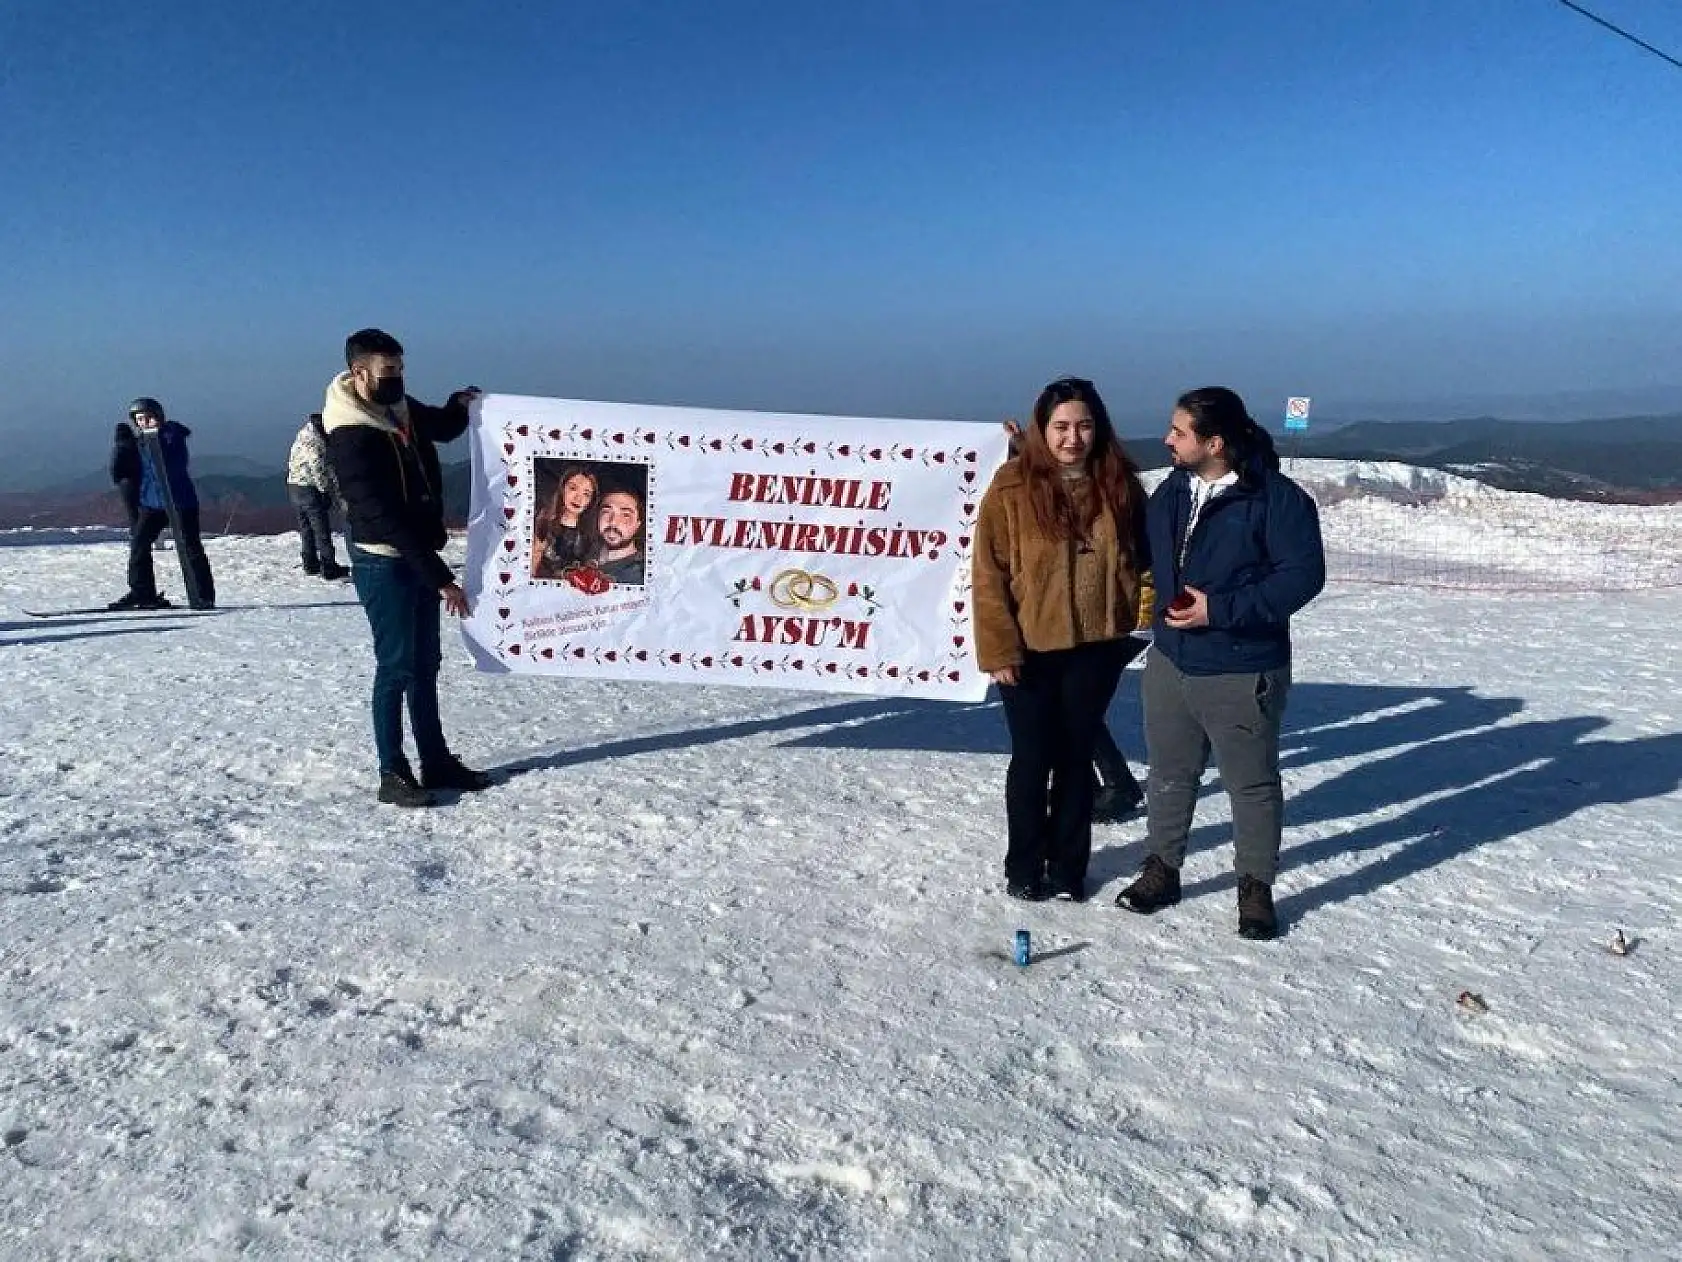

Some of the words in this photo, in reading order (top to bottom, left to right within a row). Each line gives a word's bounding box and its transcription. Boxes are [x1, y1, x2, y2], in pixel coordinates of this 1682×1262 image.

[728, 469, 892, 511] BENİMLE
[664, 514, 947, 559] EVLENİRMİSİN?
[732, 614, 872, 649] AYSU'M
